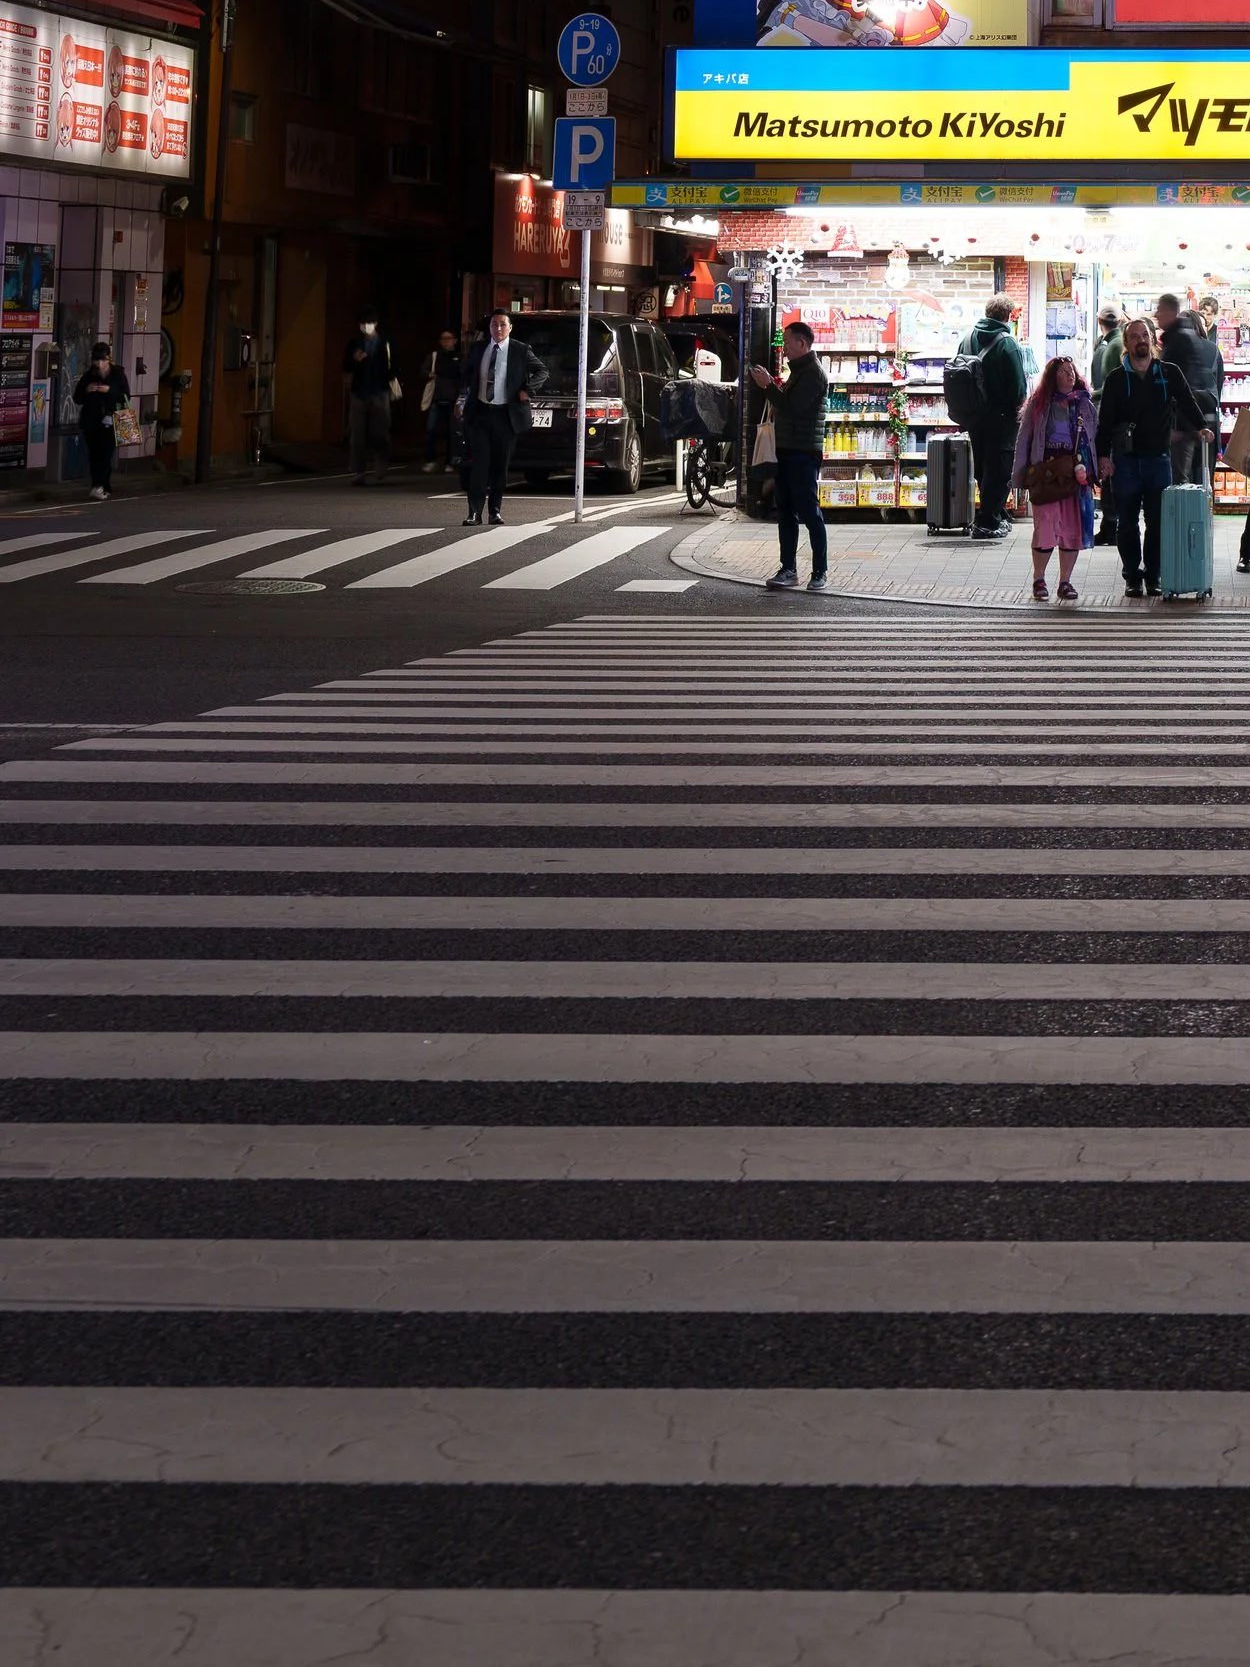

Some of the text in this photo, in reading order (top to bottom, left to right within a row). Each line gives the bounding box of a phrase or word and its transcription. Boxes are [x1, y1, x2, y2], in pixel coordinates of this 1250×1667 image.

[579, 20, 600, 30] 9-19
[572, 31, 595, 74] P
[587, 55, 605, 75] 60
[703, 73, 749, 85] アキバ店
[569, 103, 604, 112] ここから
[733, 112, 1067, 138] Matsumoto KiYoshi
[571, 126, 604, 182] P
[671, 186, 708, 198] 支付宝
[744, 187, 778, 197] 微信支付
[926, 187, 962, 197] 支付宝
[1000, 187, 1033, 196] 微信支付
[568, 195, 576, 204] 19
[595, 195, 600, 204] 9
[566, 218, 602, 226] ここから
[514, 223, 563, 254] HARERUYA
[803, 307, 826, 321] Q10
[877, 493, 894, 501] 888
